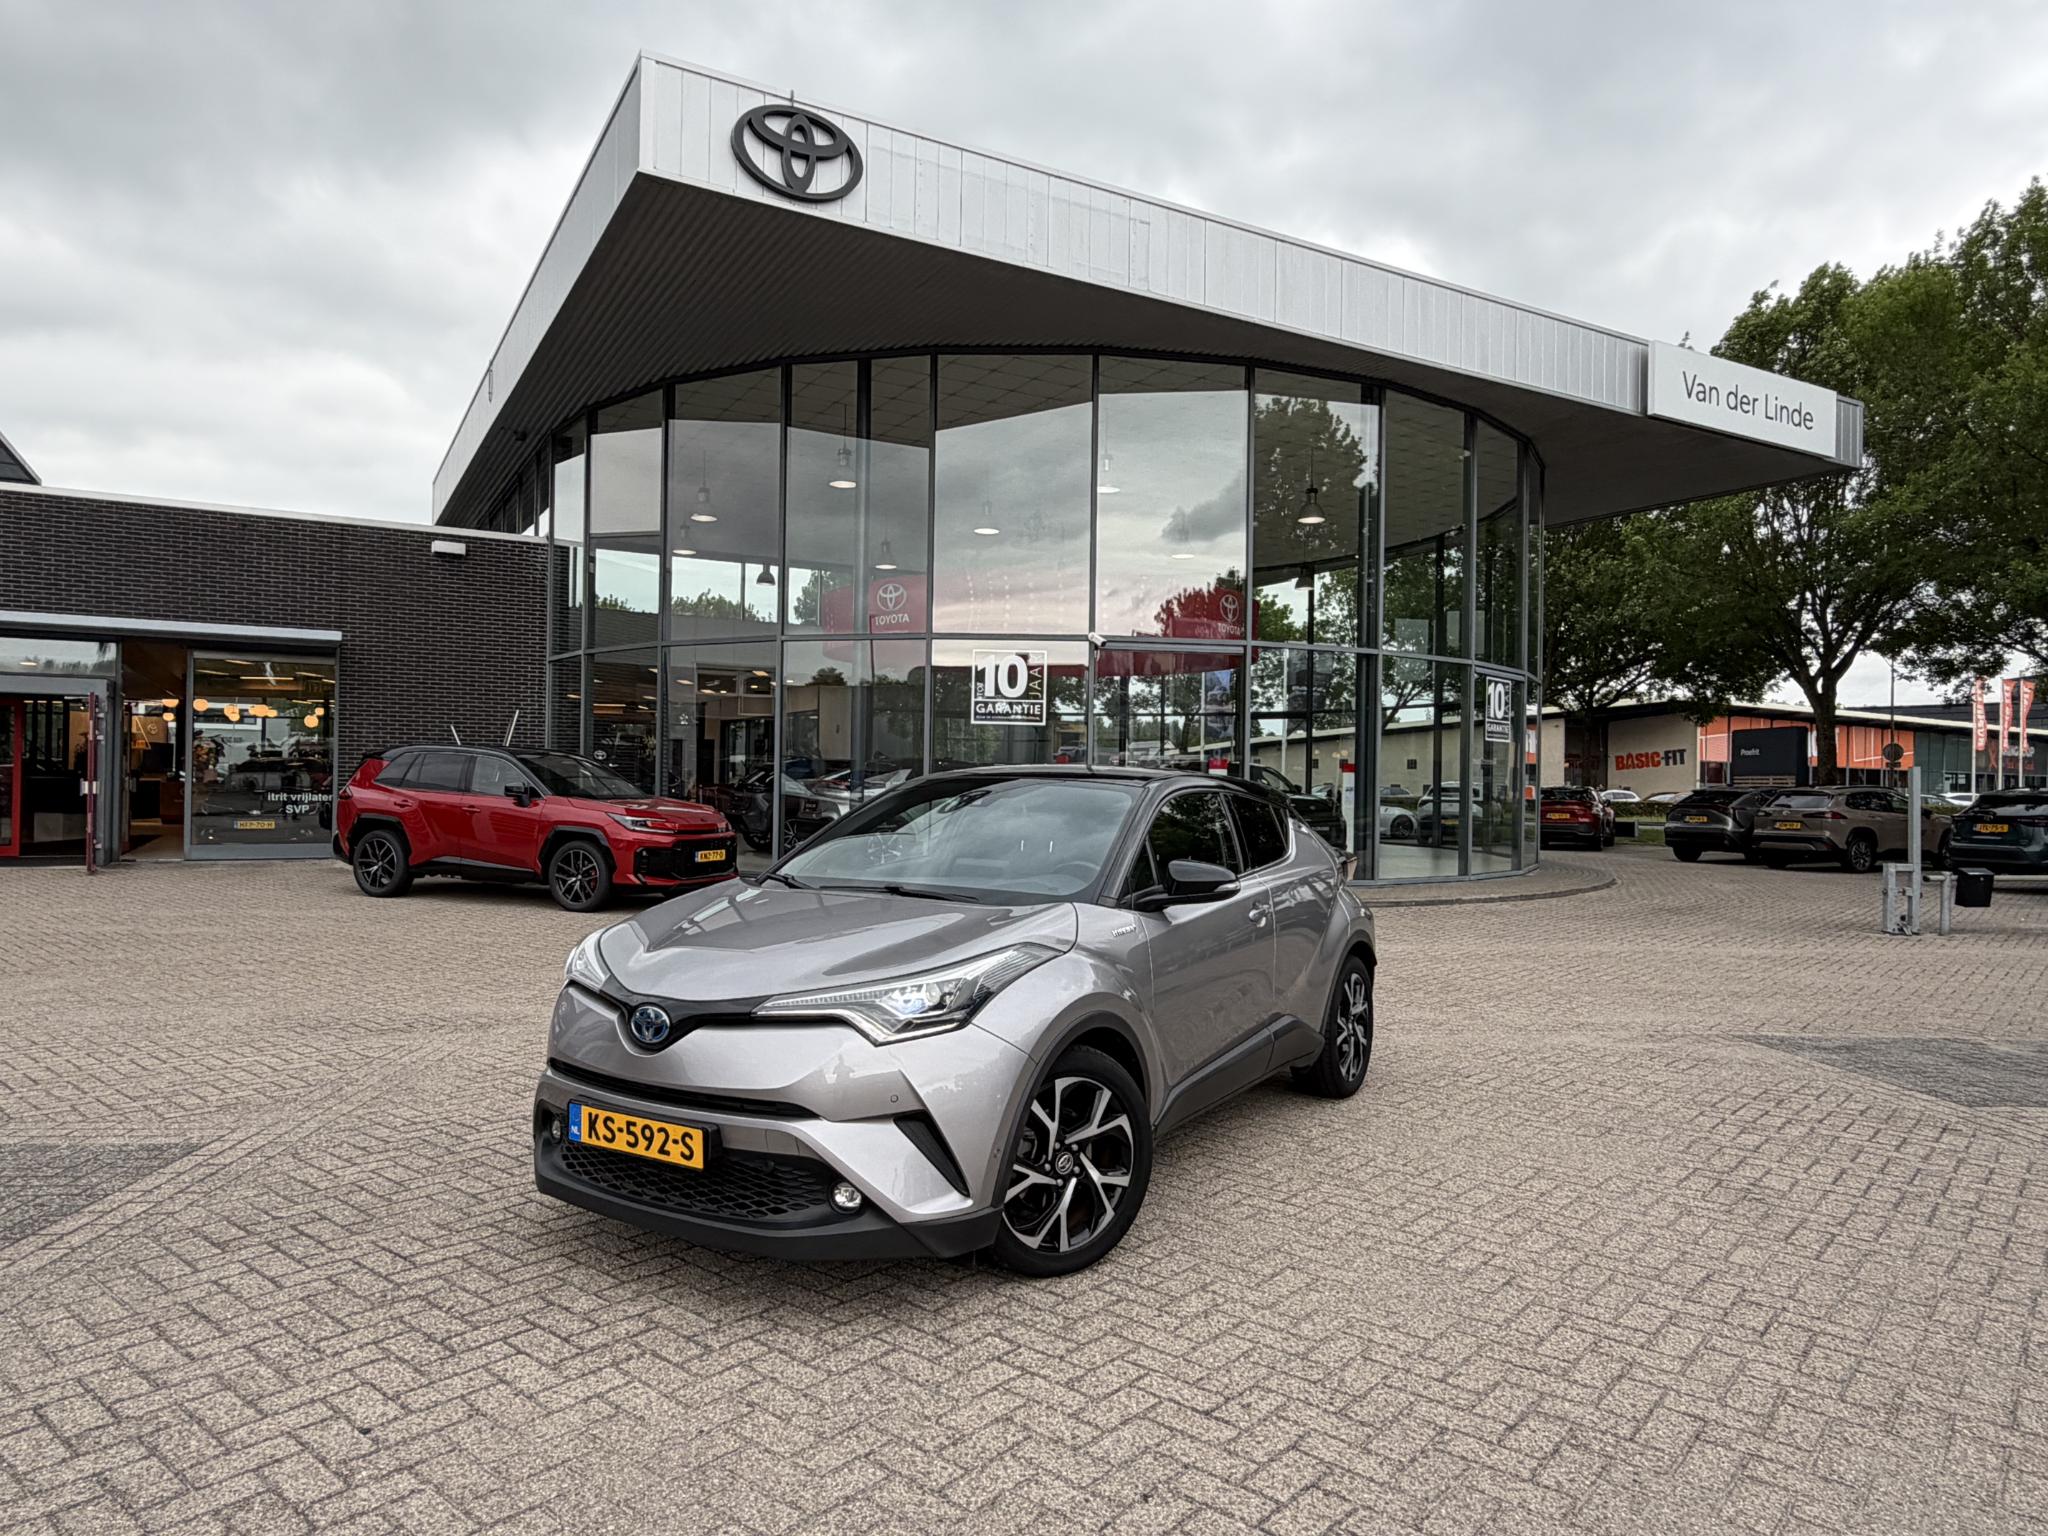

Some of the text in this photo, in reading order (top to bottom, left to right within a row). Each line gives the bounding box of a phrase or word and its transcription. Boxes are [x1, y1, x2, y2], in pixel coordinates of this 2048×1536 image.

[1682, 370, 1814, 431] Van der Linde
[875, 613, 910, 626] TOYOTA
[977, 654, 1028, 699] 10
[975, 703, 1041, 715] GARANTIE
[1488, 681, 1505, 720] 10
[1615, 748, 1687, 771] BASIC-FIT
[285, 804, 310, 814] SVP
[588, 1111, 695, 1162] KS-592-S
